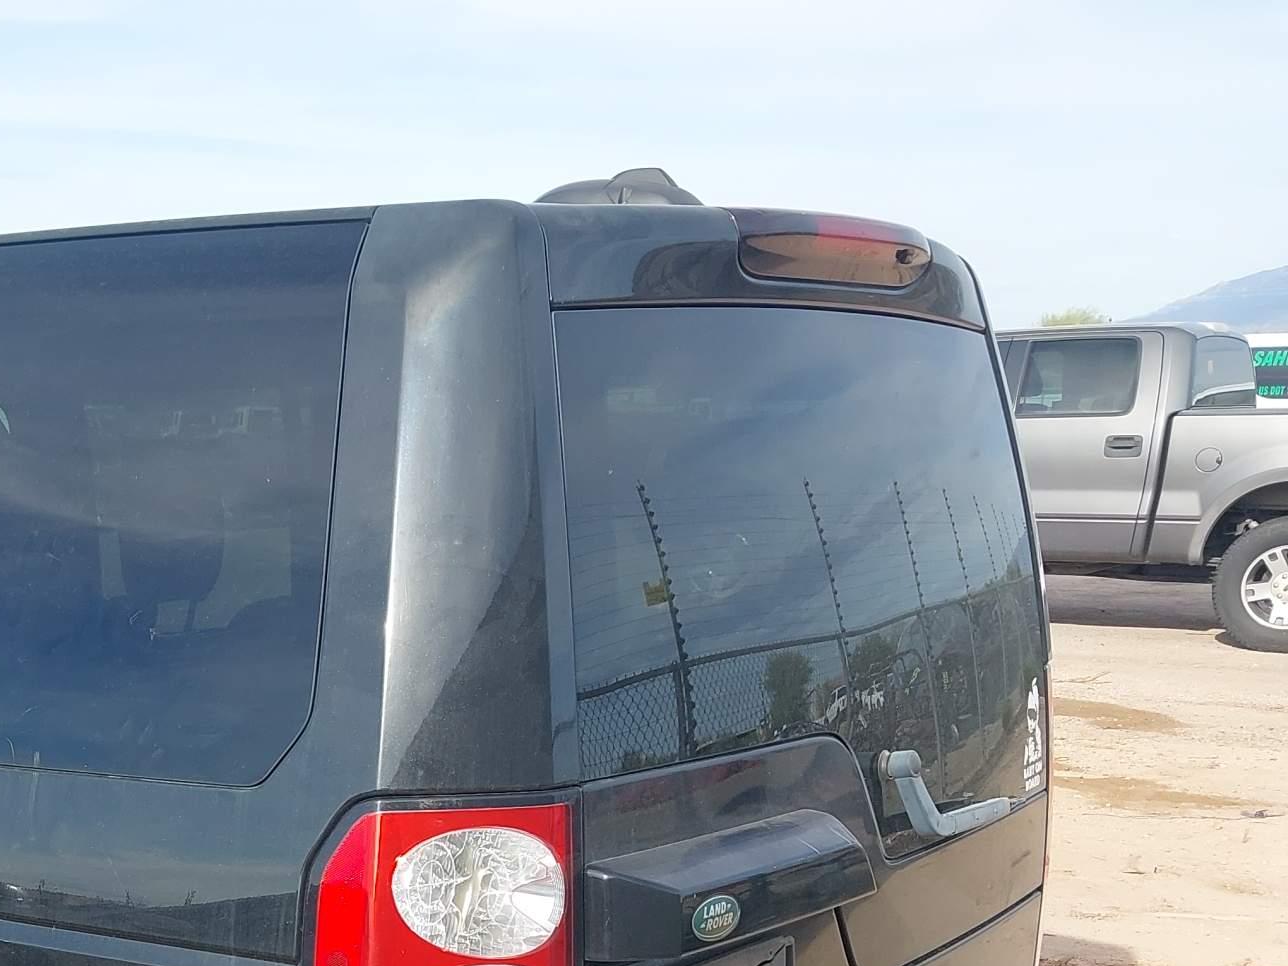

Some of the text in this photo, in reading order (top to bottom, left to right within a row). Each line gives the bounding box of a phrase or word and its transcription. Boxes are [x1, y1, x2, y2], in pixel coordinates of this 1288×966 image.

[1258, 385, 1286, 396] US DOT
[703, 901, 727, 919] LAND
[705, 912, 734, 932] ROVER
